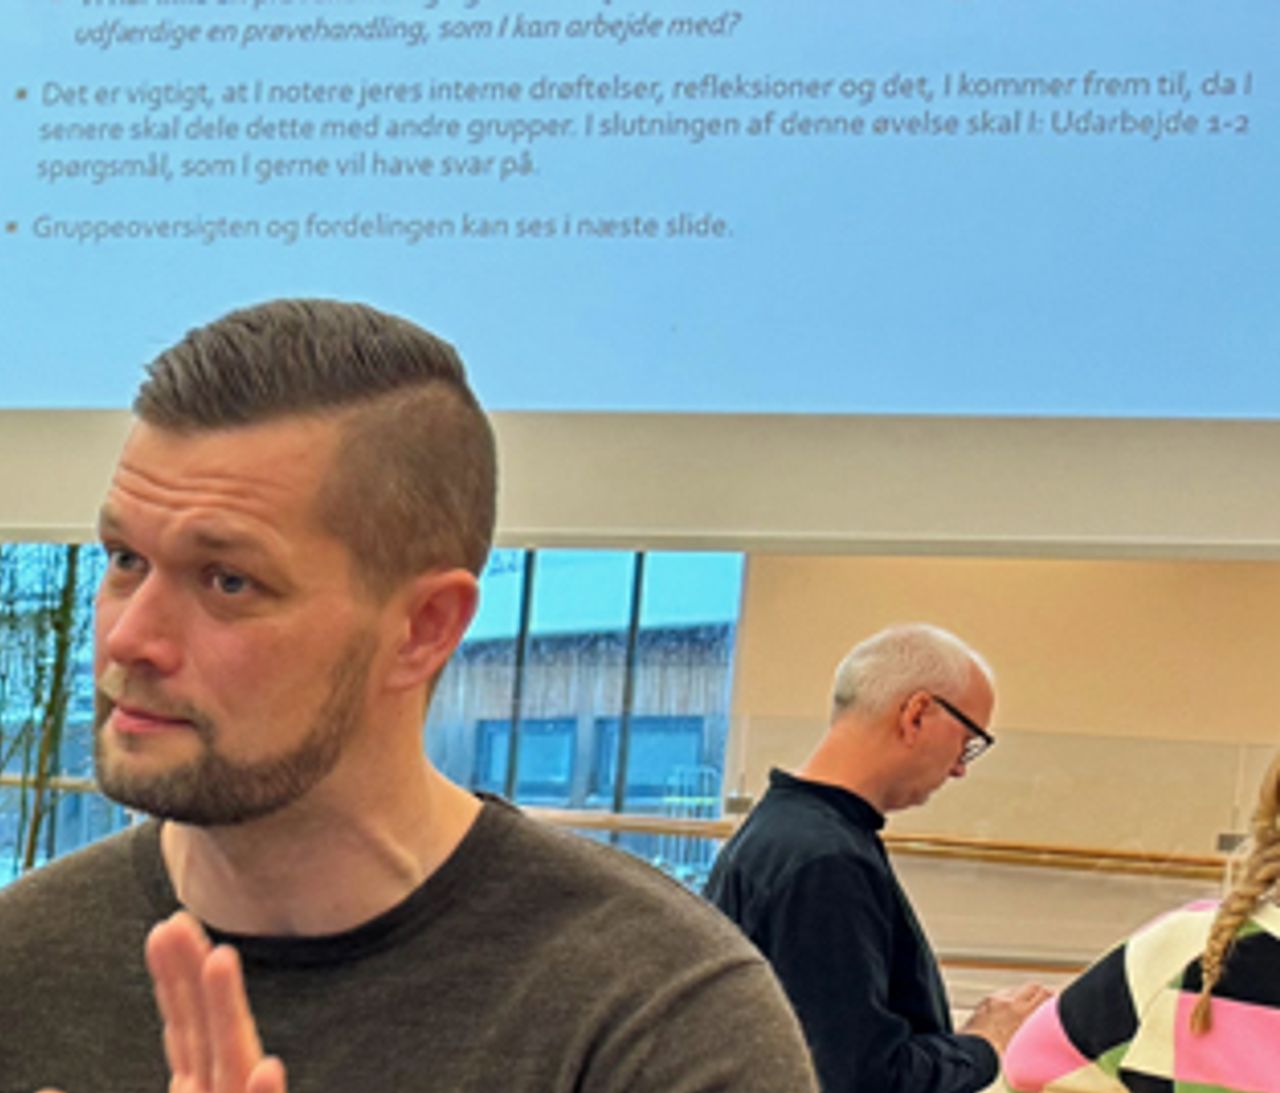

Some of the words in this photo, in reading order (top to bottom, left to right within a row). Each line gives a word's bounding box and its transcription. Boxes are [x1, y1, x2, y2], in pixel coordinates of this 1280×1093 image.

[74, 20, 203, 51] udfærdige
[205, 24, 239, 43] en
[240, 16, 430, 49] prøvehandling,
[438, 20, 494, 40] som
[511, 12, 561, 39] kan
[564, 11, 665, 46] arbejde
[666, 10, 743, 38] med?
[41, 81, 89, 107] Det
[93, 86, 121, 106] er
[126, 83, 215, 111] vigtigt,
[221, 83, 249, 104] at
[268, 81, 353, 104] notere
[356, 82, 423, 110] jeres
[428, 80, 523, 102] interne
[527, 73, 665, 105] drøftelser,
[671, 73, 835, 100] refleksioner
[838, 78, 876, 106] og
[881, 72, 934, 103] det,
[957, 71, 1078, 98] kommer
[1082, 69, 1151, 97] frem
[1156, 71, 1192, 102] til,
[1199, 70, 1237, 97] da
[38, 122, 125, 141] senere
[129, 116, 179, 141] skal
[184, 116, 240, 141] dele
[245, 115, 316, 141] dette
[319, 115, 380, 140] med
[384, 114, 462, 139] andre
[598, 112, 741, 144] slutningen
[745, 110, 775, 137] af
[779, 111, 866, 137] denne
[871, 110, 960, 136] øvelse
[966, 109, 1022, 136] skal
[1050, 109, 1199, 142] Udarbejde
[1207, 114, 1250, 134] 1-2
[36, 152, 174, 186] spørgsmål,
[180, 158, 236, 178] som
[254, 158, 330, 185] gerne
[335, 151, 366, 177] vil
[371, 151, 435, 177] have
[440, 156, 495, 177] svar
[32, 214, 260, 246] Gruppeoversigten
[265, 219, 300, 246] og
[305, 212, 456, 246] fordelingen
[461, 212, 509, 238] kan
[515, 218, 558, 238] ses
[576, 215, 659, 238] næste
